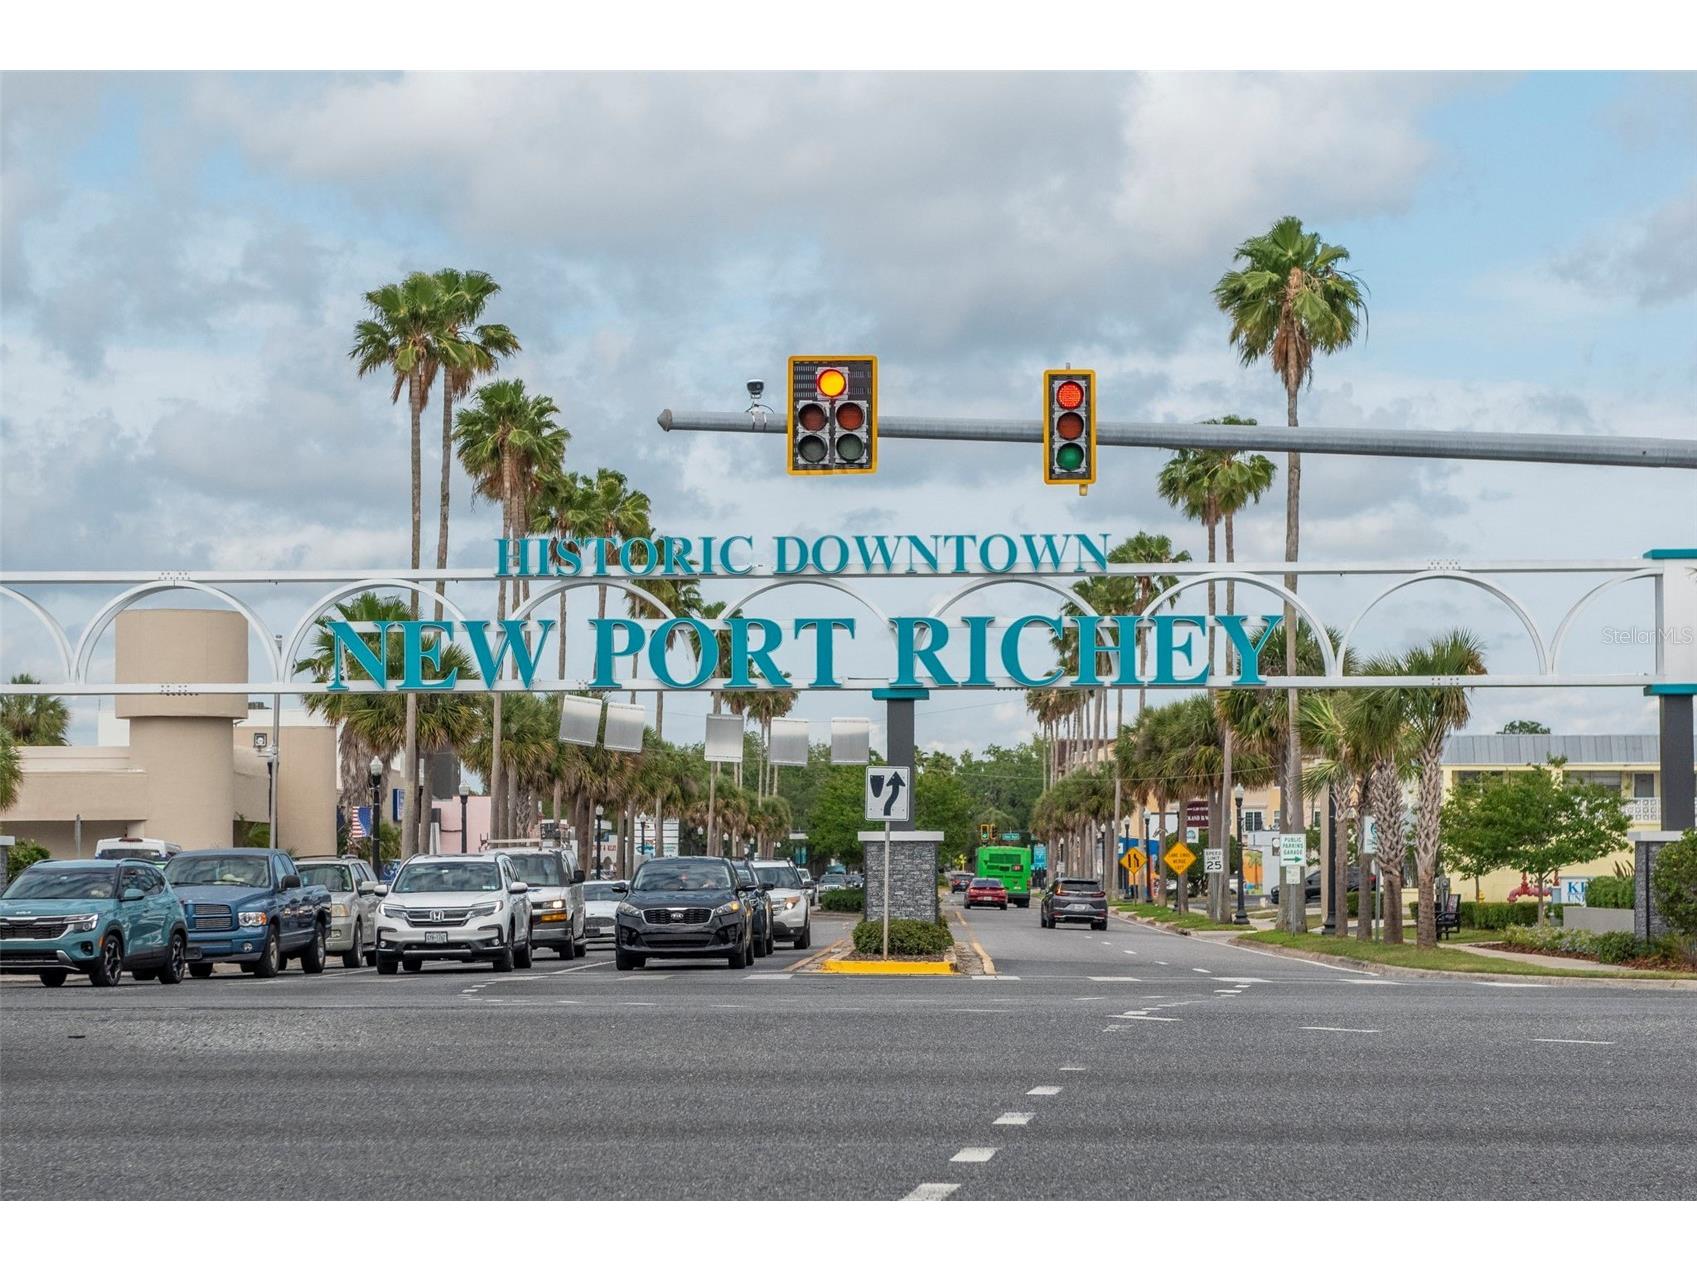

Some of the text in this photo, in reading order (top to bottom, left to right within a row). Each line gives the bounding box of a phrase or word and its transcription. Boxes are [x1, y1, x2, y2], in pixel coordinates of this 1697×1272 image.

[494, 533, 1112, 577] HISTORIC DOWNTOWN
[326, 614, 1285, 691] NEW PORT RICHEY
[1206, 861, 1222, 870] 25
